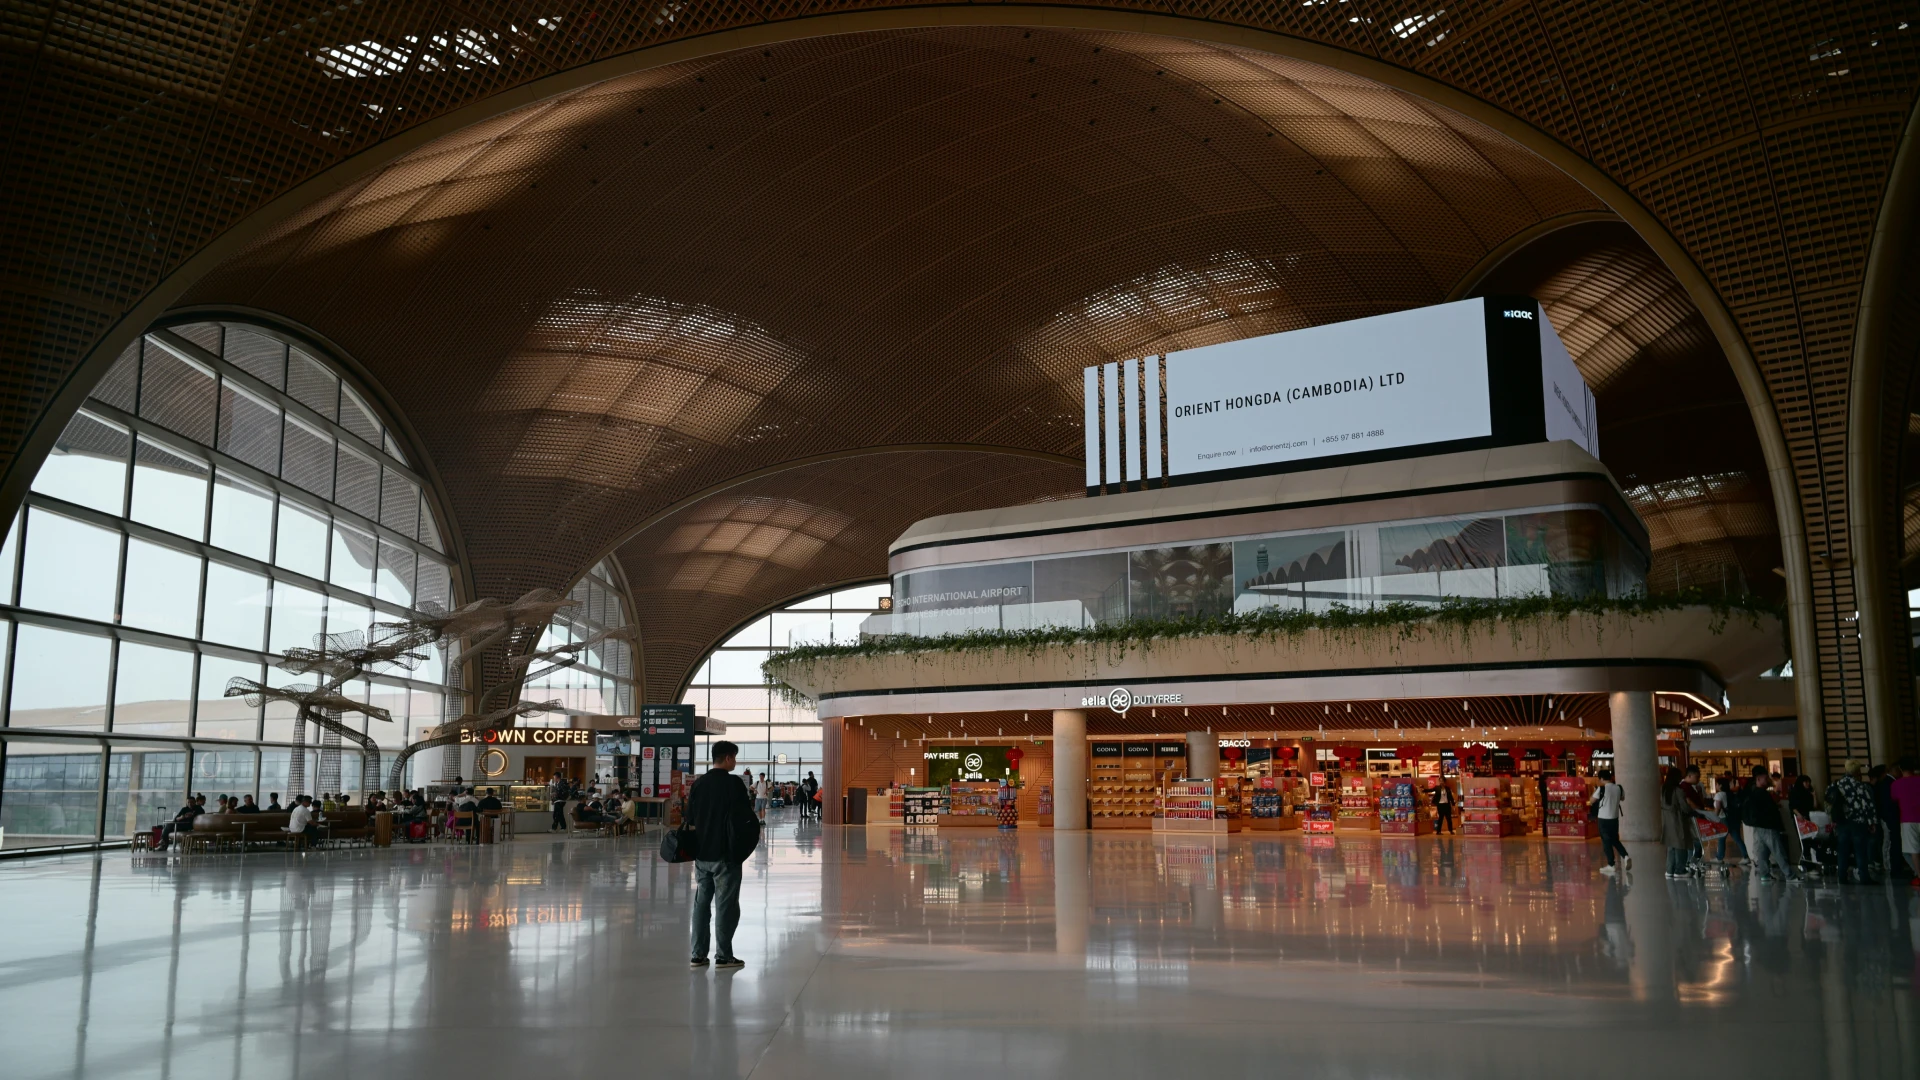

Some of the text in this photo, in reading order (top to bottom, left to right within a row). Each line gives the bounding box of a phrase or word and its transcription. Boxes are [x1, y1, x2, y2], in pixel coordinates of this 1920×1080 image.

[1175, 372, 1405, 418] ORIENT HONGDA (CAMBODIA) LTD
[1197, 429, 1385, 460] Enquire now info@orientzj.com +855 97 881 4888
[912, 590, 978, 604] INTERNATIONAL
[980, 587, 1023, 599] AIRPORT
[904, 604, 998, 621] JAPANESE FOOD COURT
[1081, 695, 1106, 706] aelia
[1133, 694, 1182, 705] DUTYFREE
[460, 729, 588, 744] BROWN COFFEE
[1218, 740, 1251, 748] OBACCO
